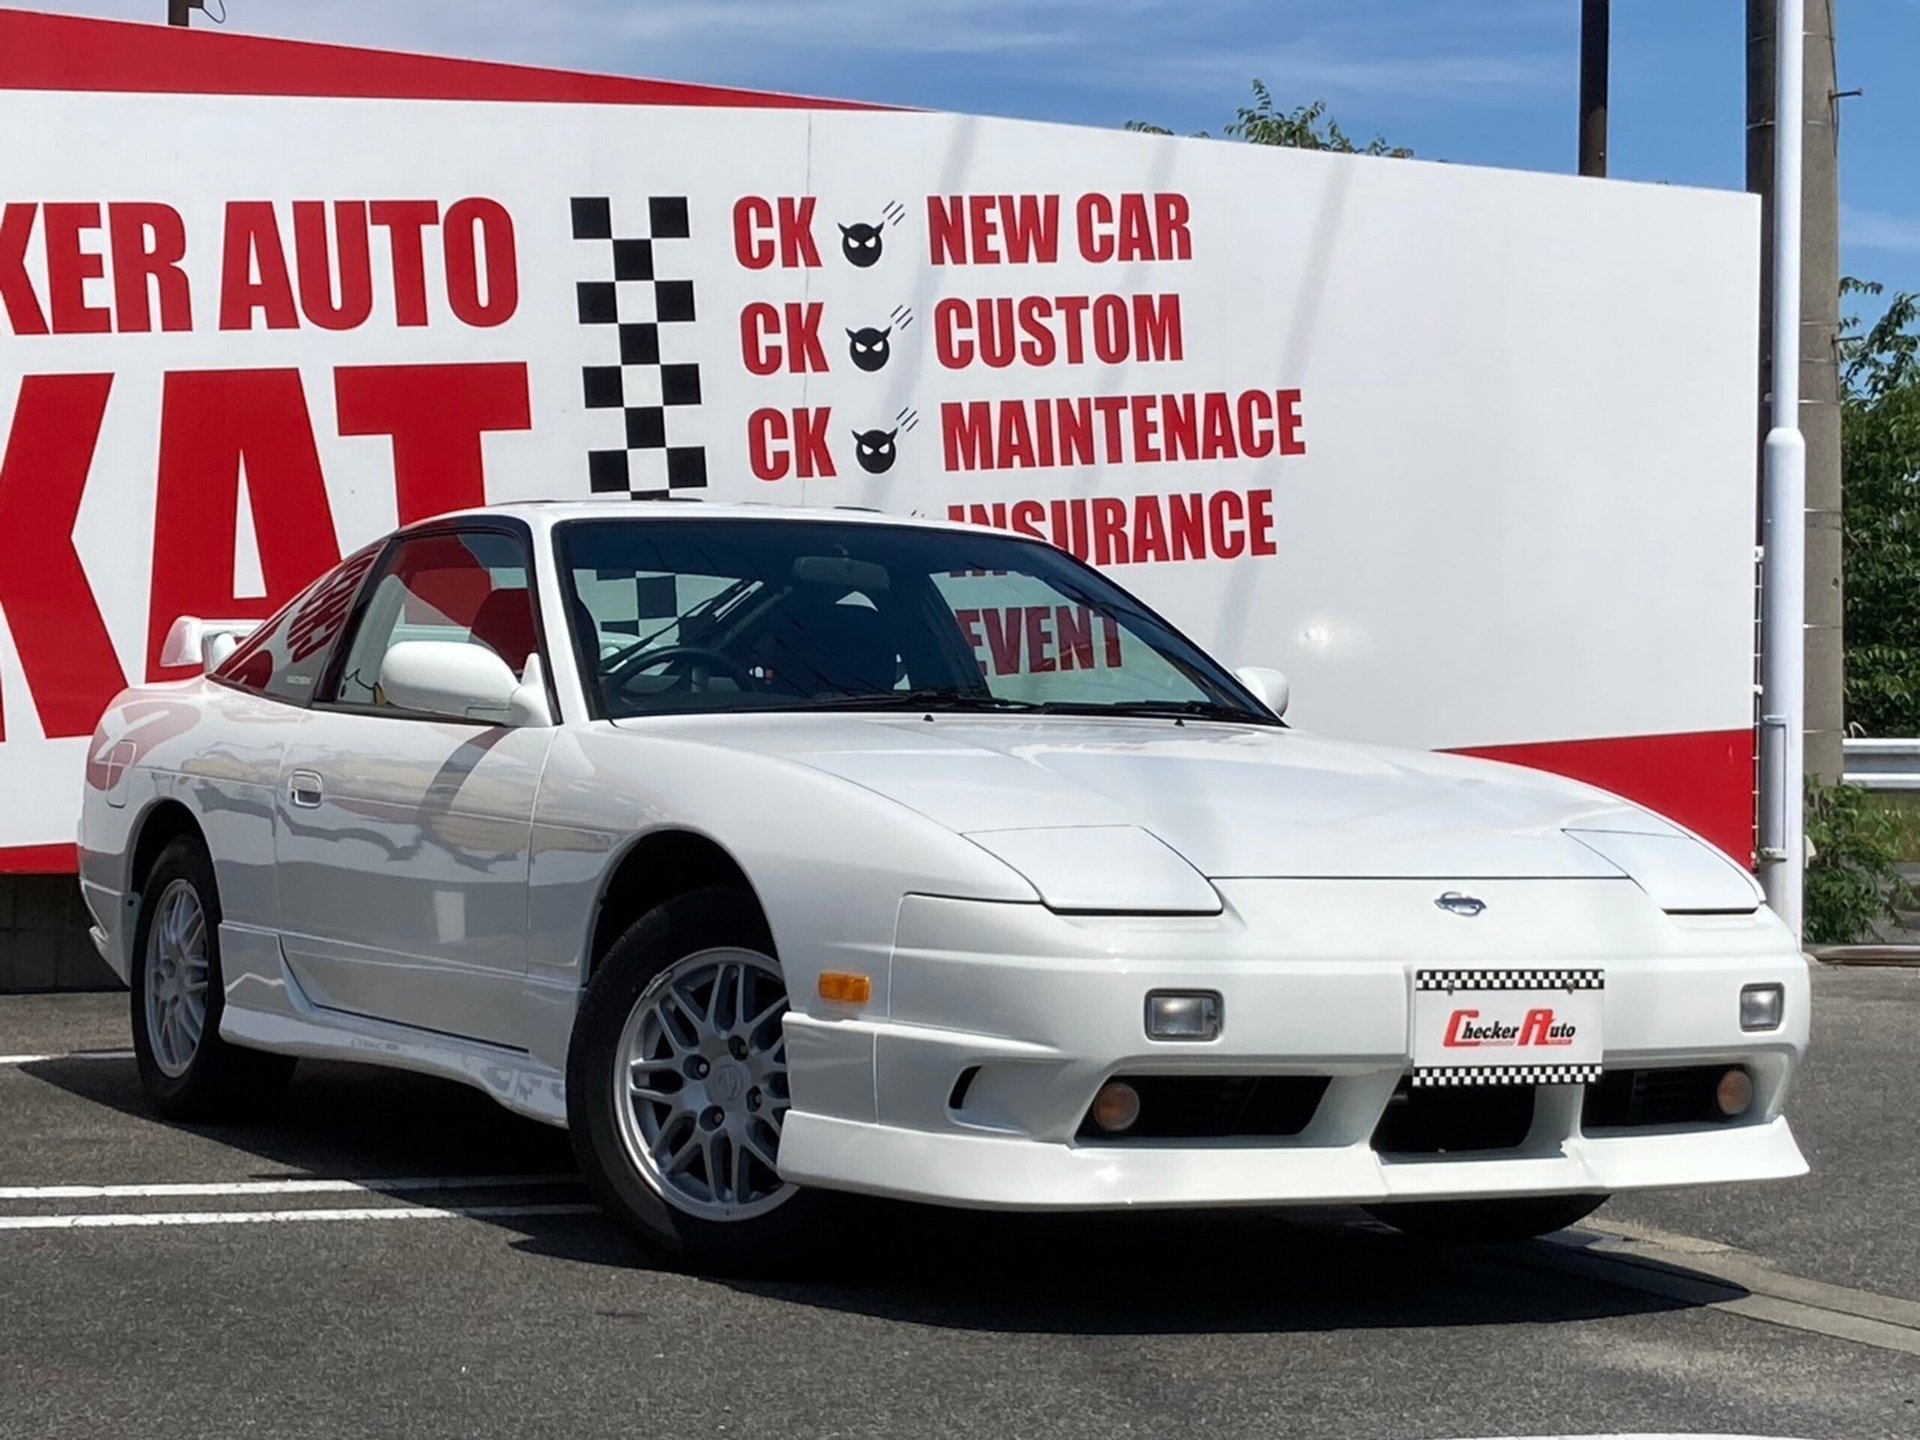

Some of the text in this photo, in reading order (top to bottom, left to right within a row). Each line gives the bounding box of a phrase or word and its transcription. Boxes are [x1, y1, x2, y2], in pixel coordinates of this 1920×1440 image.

[219, 197, 519, 331] AUTO
[734, 193, 1192, 270] CK NEW CAR
[741, 294, 1183, 376] CK CUSTOM
[748, 389, 1306, 482] CK MAINTENACE
[955, 604, 1122, 677] EVENT
[1443, 1009, 1576, 1047] Checker Auto
